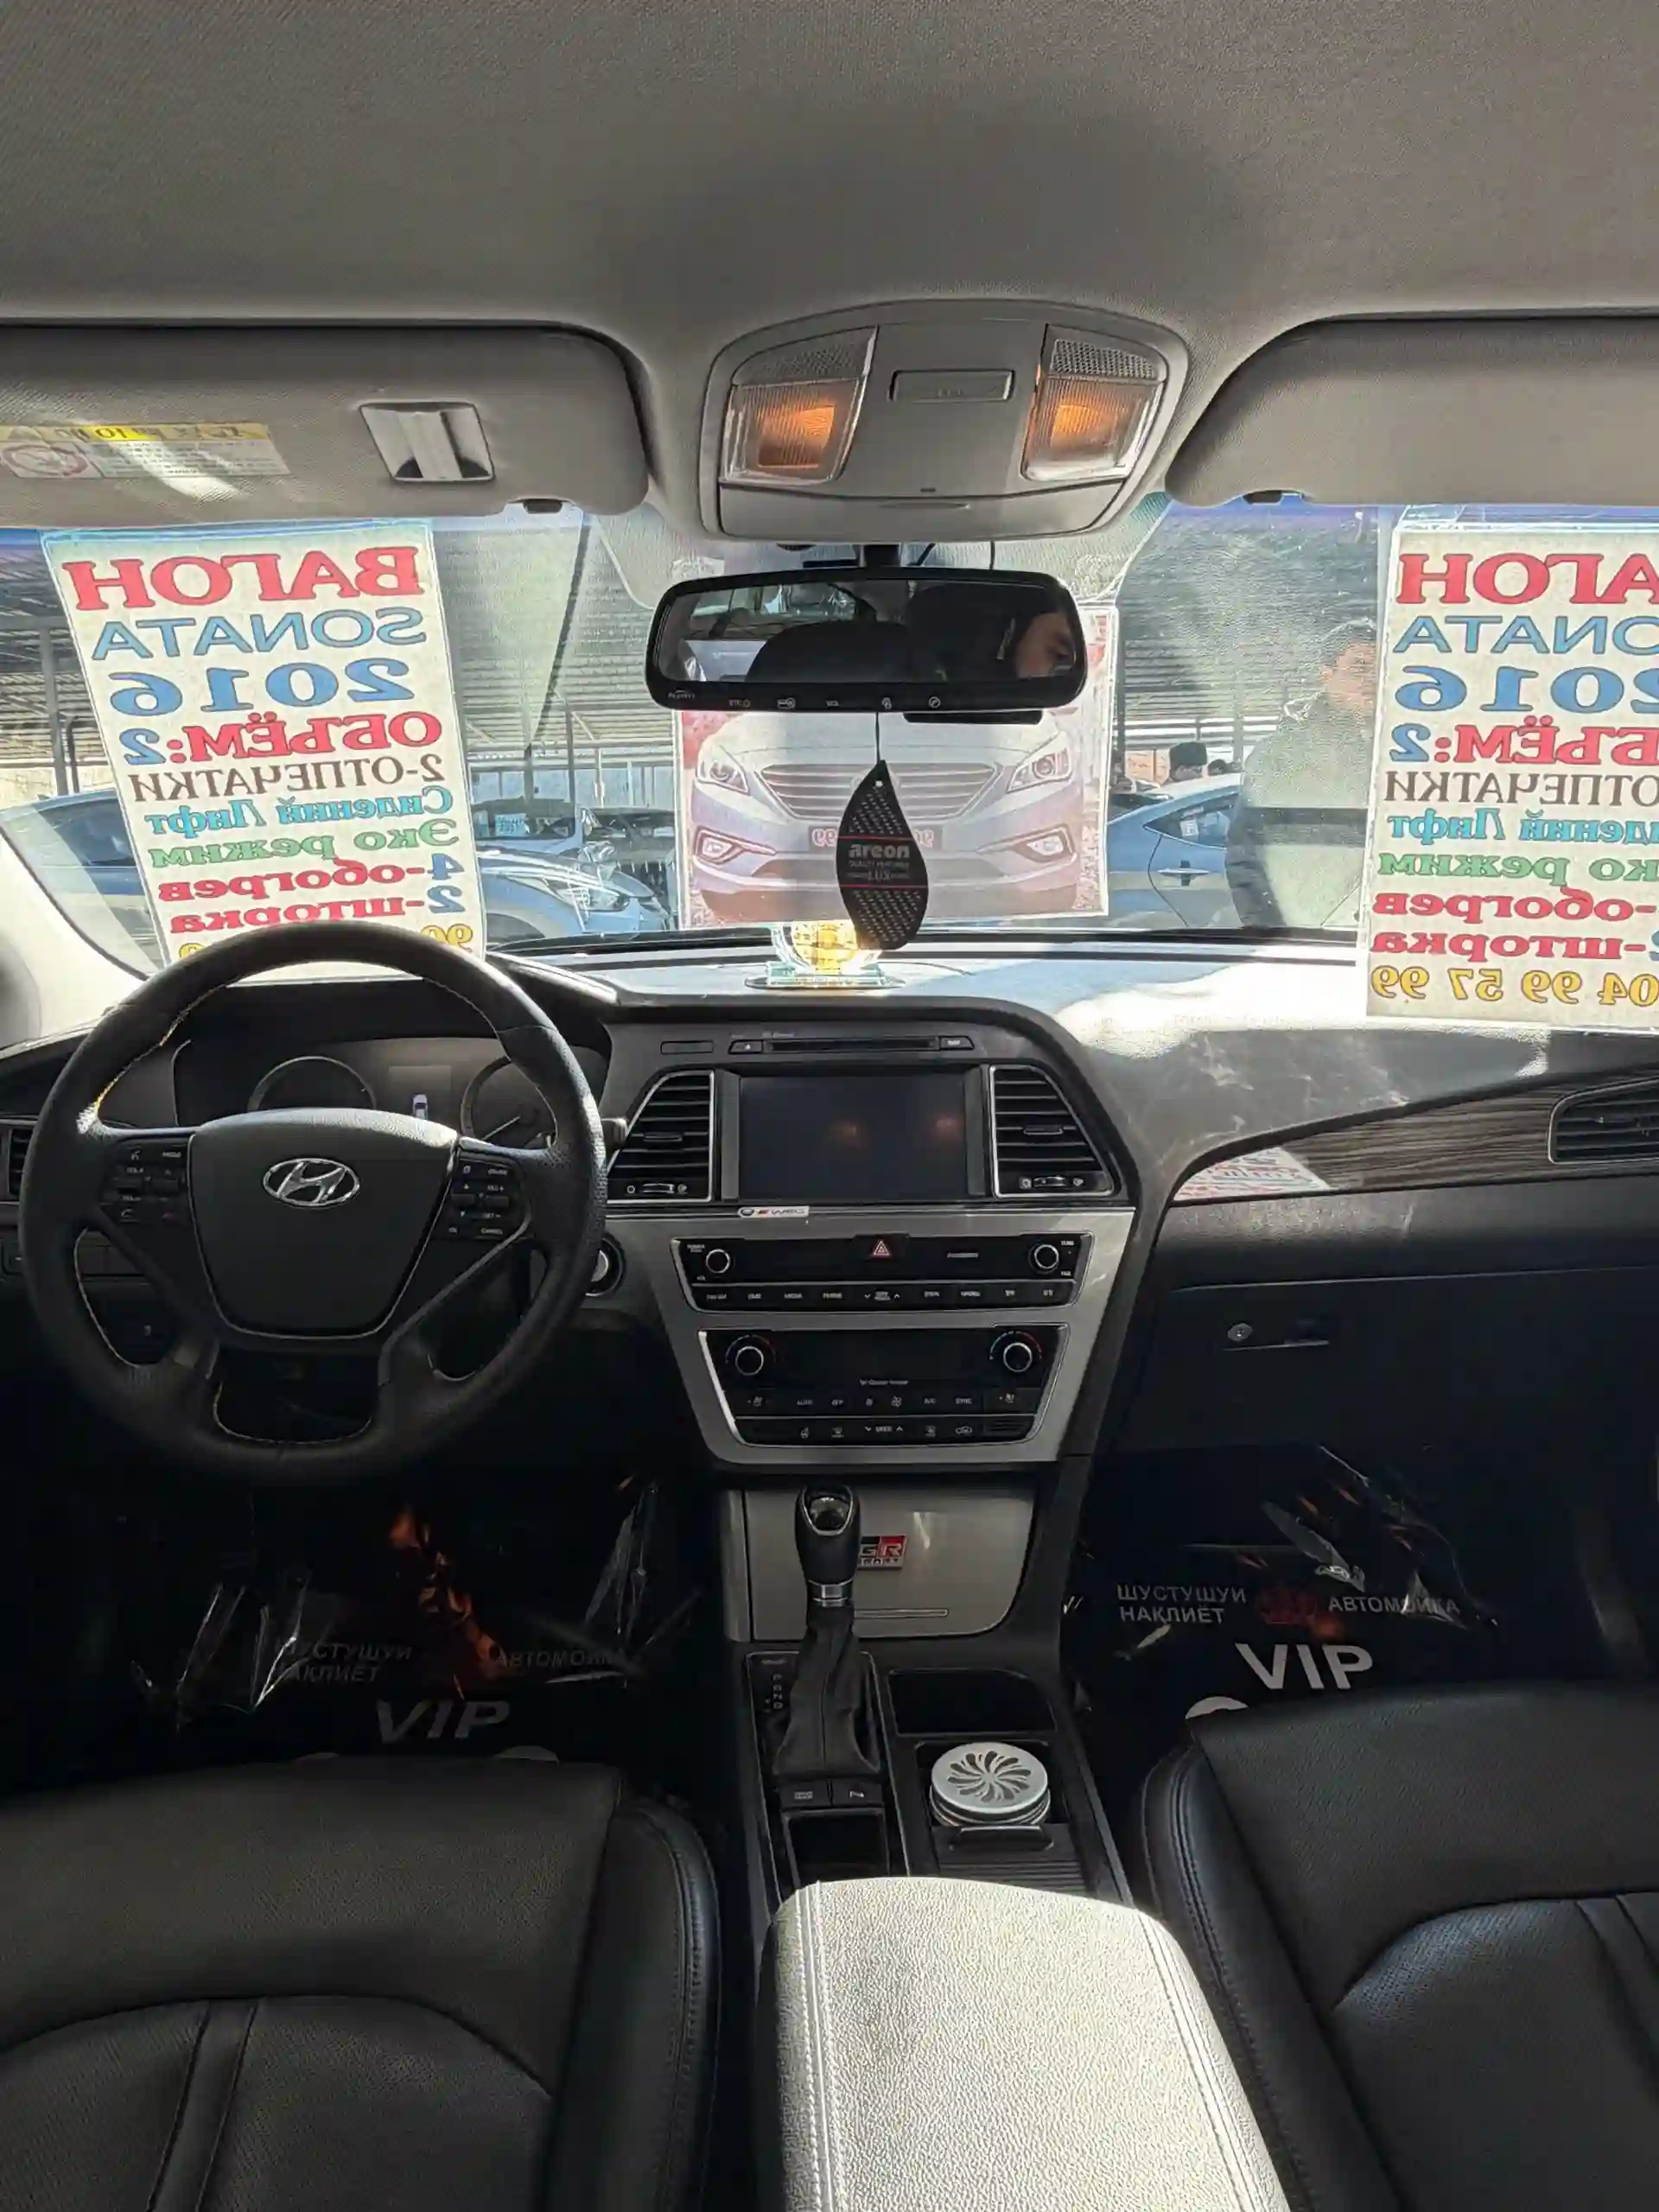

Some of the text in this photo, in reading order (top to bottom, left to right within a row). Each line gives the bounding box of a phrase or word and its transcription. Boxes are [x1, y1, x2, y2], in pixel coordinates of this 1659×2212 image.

[849, 843, 910, 859] areon
[1234, 1642, 1374, 1690] VIP
[375, 1700, 512, 1743] VIP
